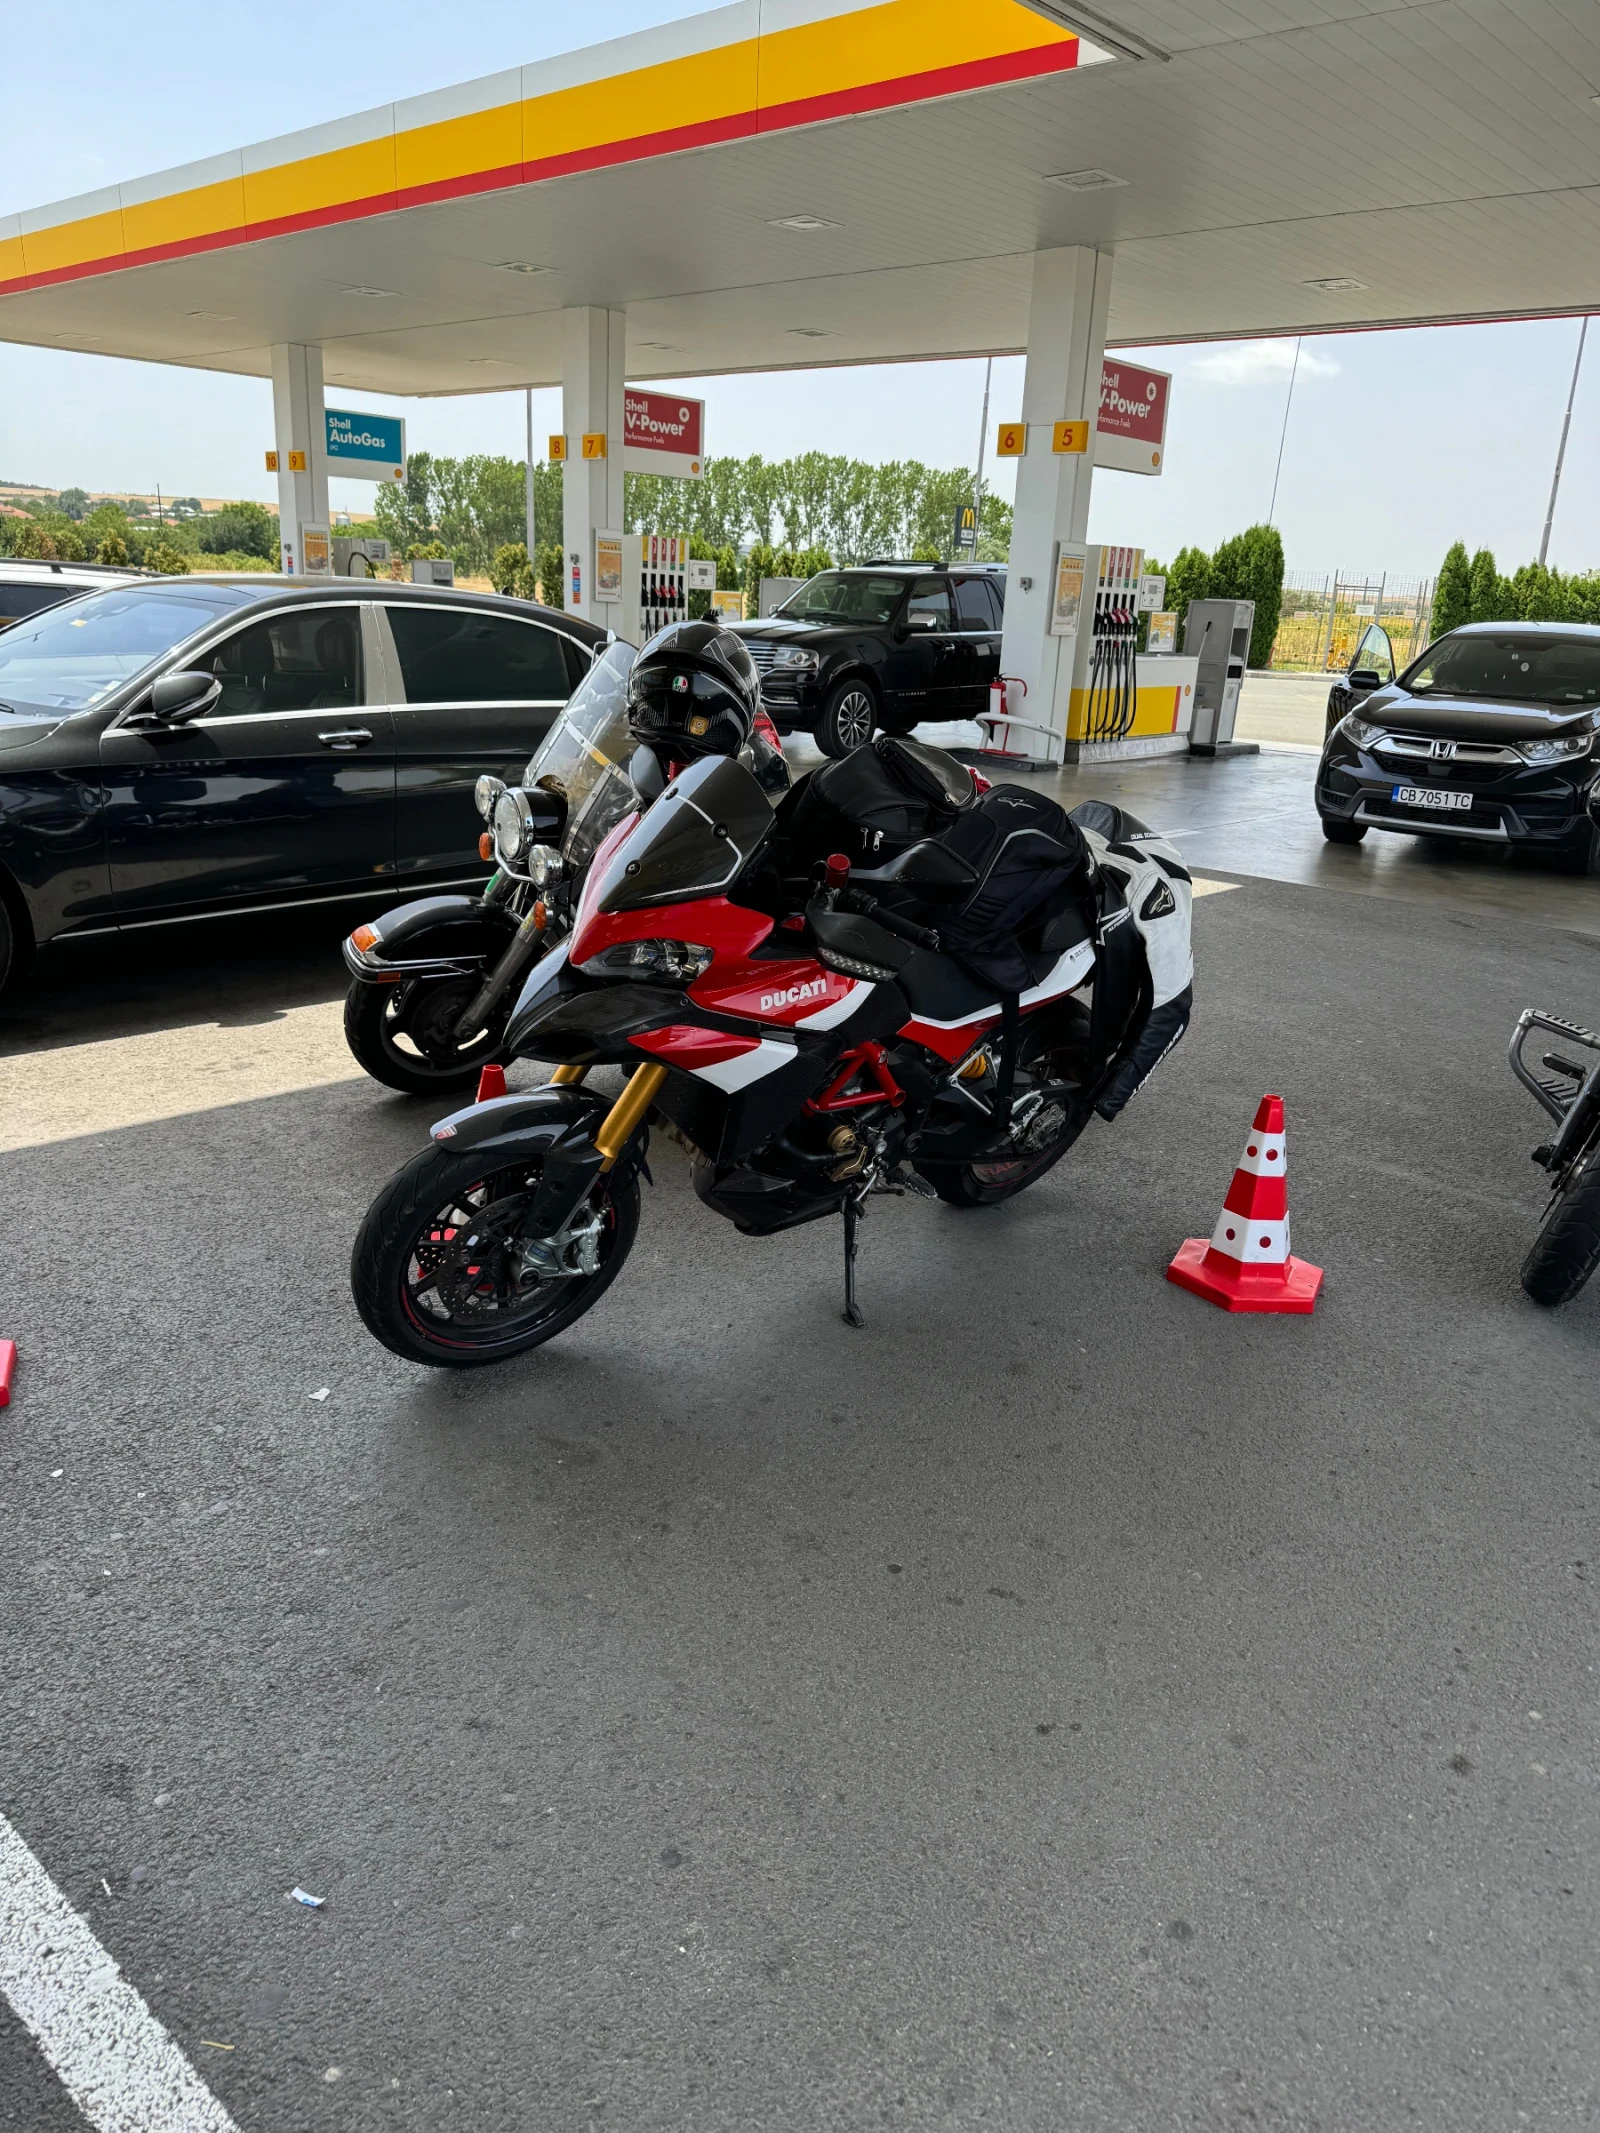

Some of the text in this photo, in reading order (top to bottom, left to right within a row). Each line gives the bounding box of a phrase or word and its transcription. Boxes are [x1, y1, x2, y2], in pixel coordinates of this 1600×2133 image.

[1100, 371, 1120, 389] hell
[625, 399, 649, 414] Shell
[328, 417, 351, 430] Shell
[625, 412, 685, 437] V-Power
[329, 429, 386, 449] AutoGas
[653, 435, 665, 445] Fuels
[1004, 431, 1015, 449] 6
[1062, 428, 1073, 447] 5
[553, 440, 561, 454] 8
[587, 439, 595, 454] 7
[267, 456, 276, 468] 10
[291, 455, 297, 467] 9
[1400, 788, 1417, 802] CB
[1418, 790, 1450, 806] 7051
[1453, 794, 1471, 808] TC
[760, 978, 827, 1012] DUCATI
